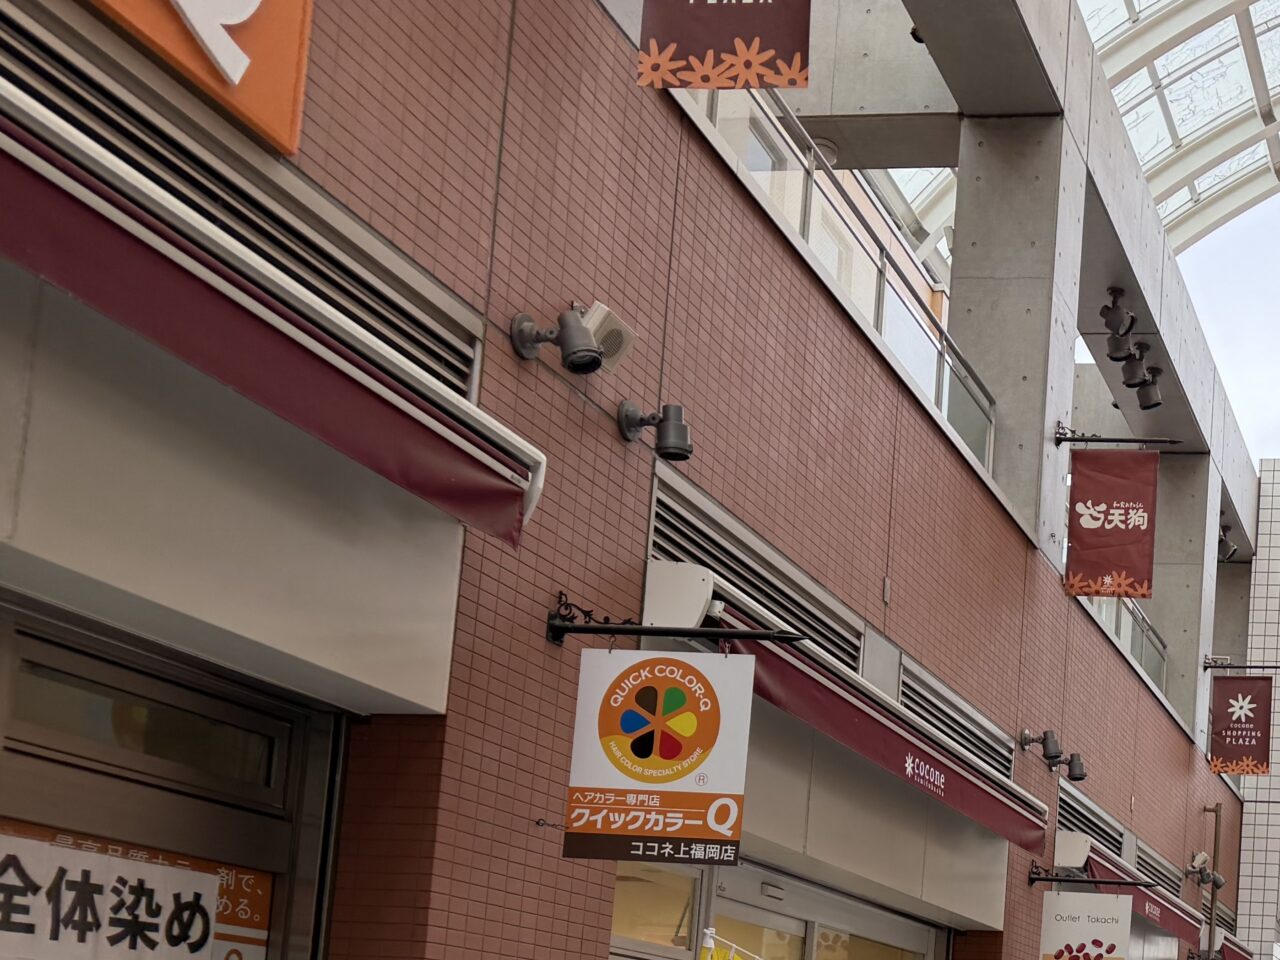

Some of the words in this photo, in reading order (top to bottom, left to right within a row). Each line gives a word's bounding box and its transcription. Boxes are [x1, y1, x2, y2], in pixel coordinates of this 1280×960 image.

[1104, 509, 1148, 530] 天狗
[610, 666, 653, 708] QUICK
[655, 665, 711, 712] COLOR-Q
[1226, 737, 1257, 745] PLAZA
[609, 741, 622, 759] HAIR
[619, 756, 643, 775] COLOR
[643, 764, 683, 777] SPECIALTY
[682, 746, 704, 768] STORE
[914, 758, 945, 788] cocone
[573, 792, 660, 806] ヘアカラー専門店
[630, 842, 736, 861] ココネ上福岡店
[0, 854, 210, 954] 全体染め
[1055, 914, 1080, 923] Outlet
[1087, 915, 1119, 924] Tokachi
